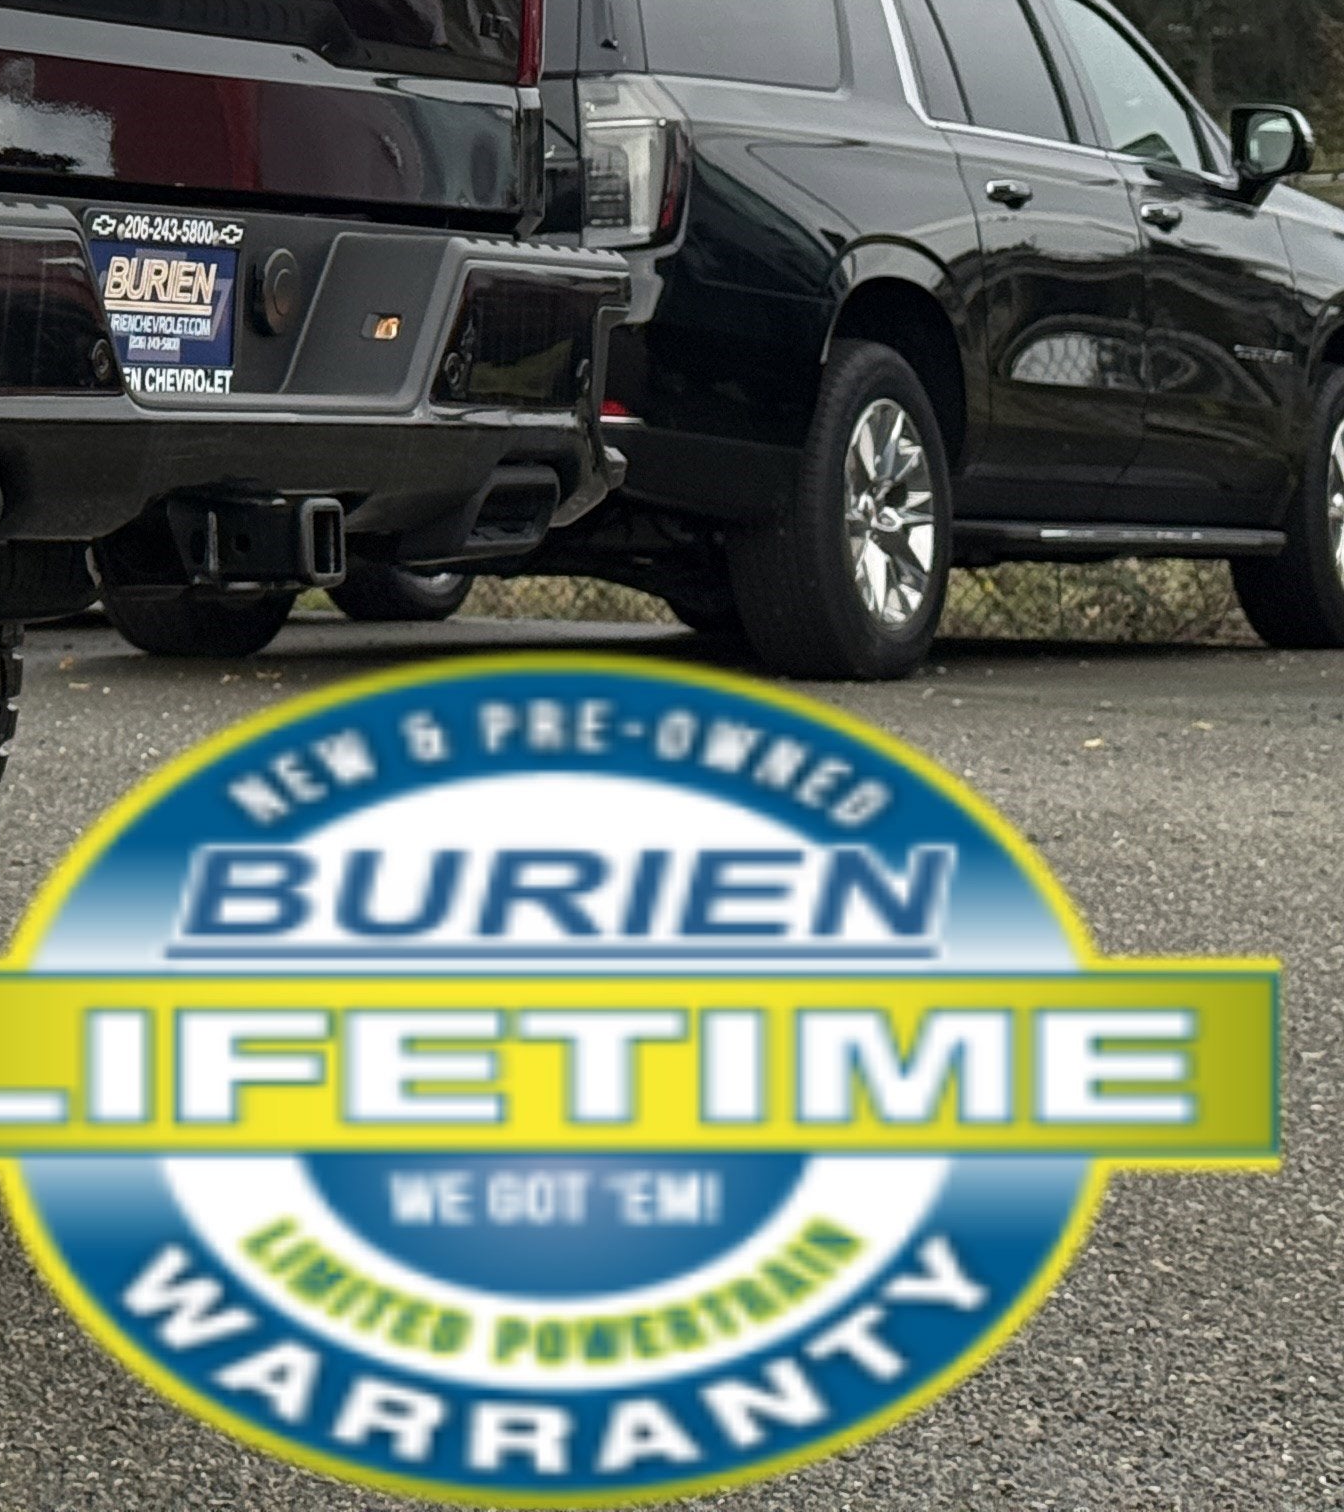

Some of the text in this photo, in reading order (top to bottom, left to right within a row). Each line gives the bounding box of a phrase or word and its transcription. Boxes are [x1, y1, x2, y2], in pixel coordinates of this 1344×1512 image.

[124, 215, 214, 245] 206-243-5800
[104, 255, 217, 305] BURIEN
[144, 368, 234, 395] CHEVROLET
